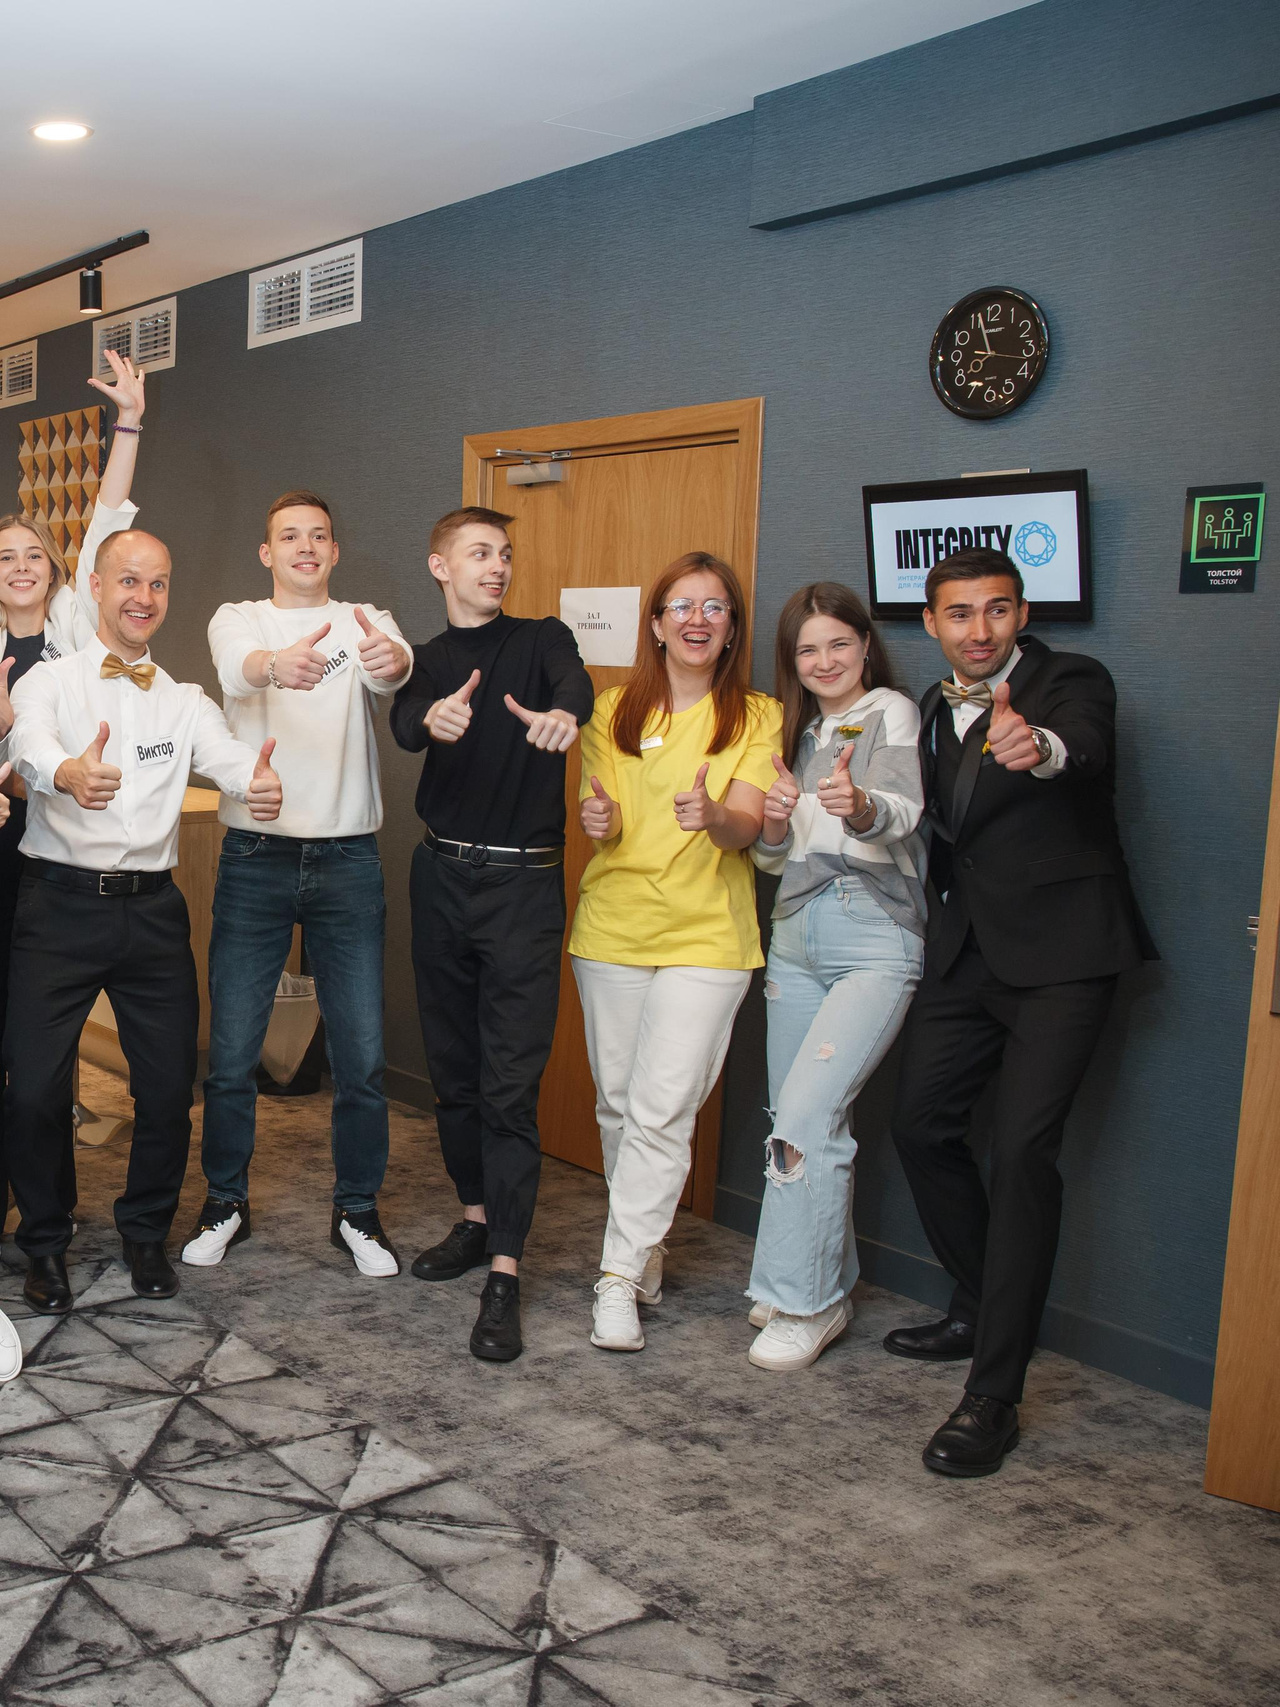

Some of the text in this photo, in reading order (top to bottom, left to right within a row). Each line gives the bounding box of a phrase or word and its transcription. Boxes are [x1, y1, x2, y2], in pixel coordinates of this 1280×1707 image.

[987, 304, 1001, 321] 12
[1010, 307, 1015, 323] 1
[970, 313, 983, 329] 11
[1019, 320, 1031, 337] 2
[954, 330, 970, 346] 10
[1022, 340, 1035, 357] 3
[951, 350, 962, 366] 9
[955, 369, 966, 386] 8
[1017, 361, 1028, 378] 4
[968, 381, 983, 399] 7
[984, 386, 996, 402] 6
[1003, 379, 1014, 394] 5
[1207, 568, 1242, 577] ТОЛСТОЙ
[587, 612, 600, 620] ЗАЛ
[577, 622, 612, 630] ТРЕНИНГА
[322, 649, 349, 677] лья
[136, 741, 174, 761] Виктор
